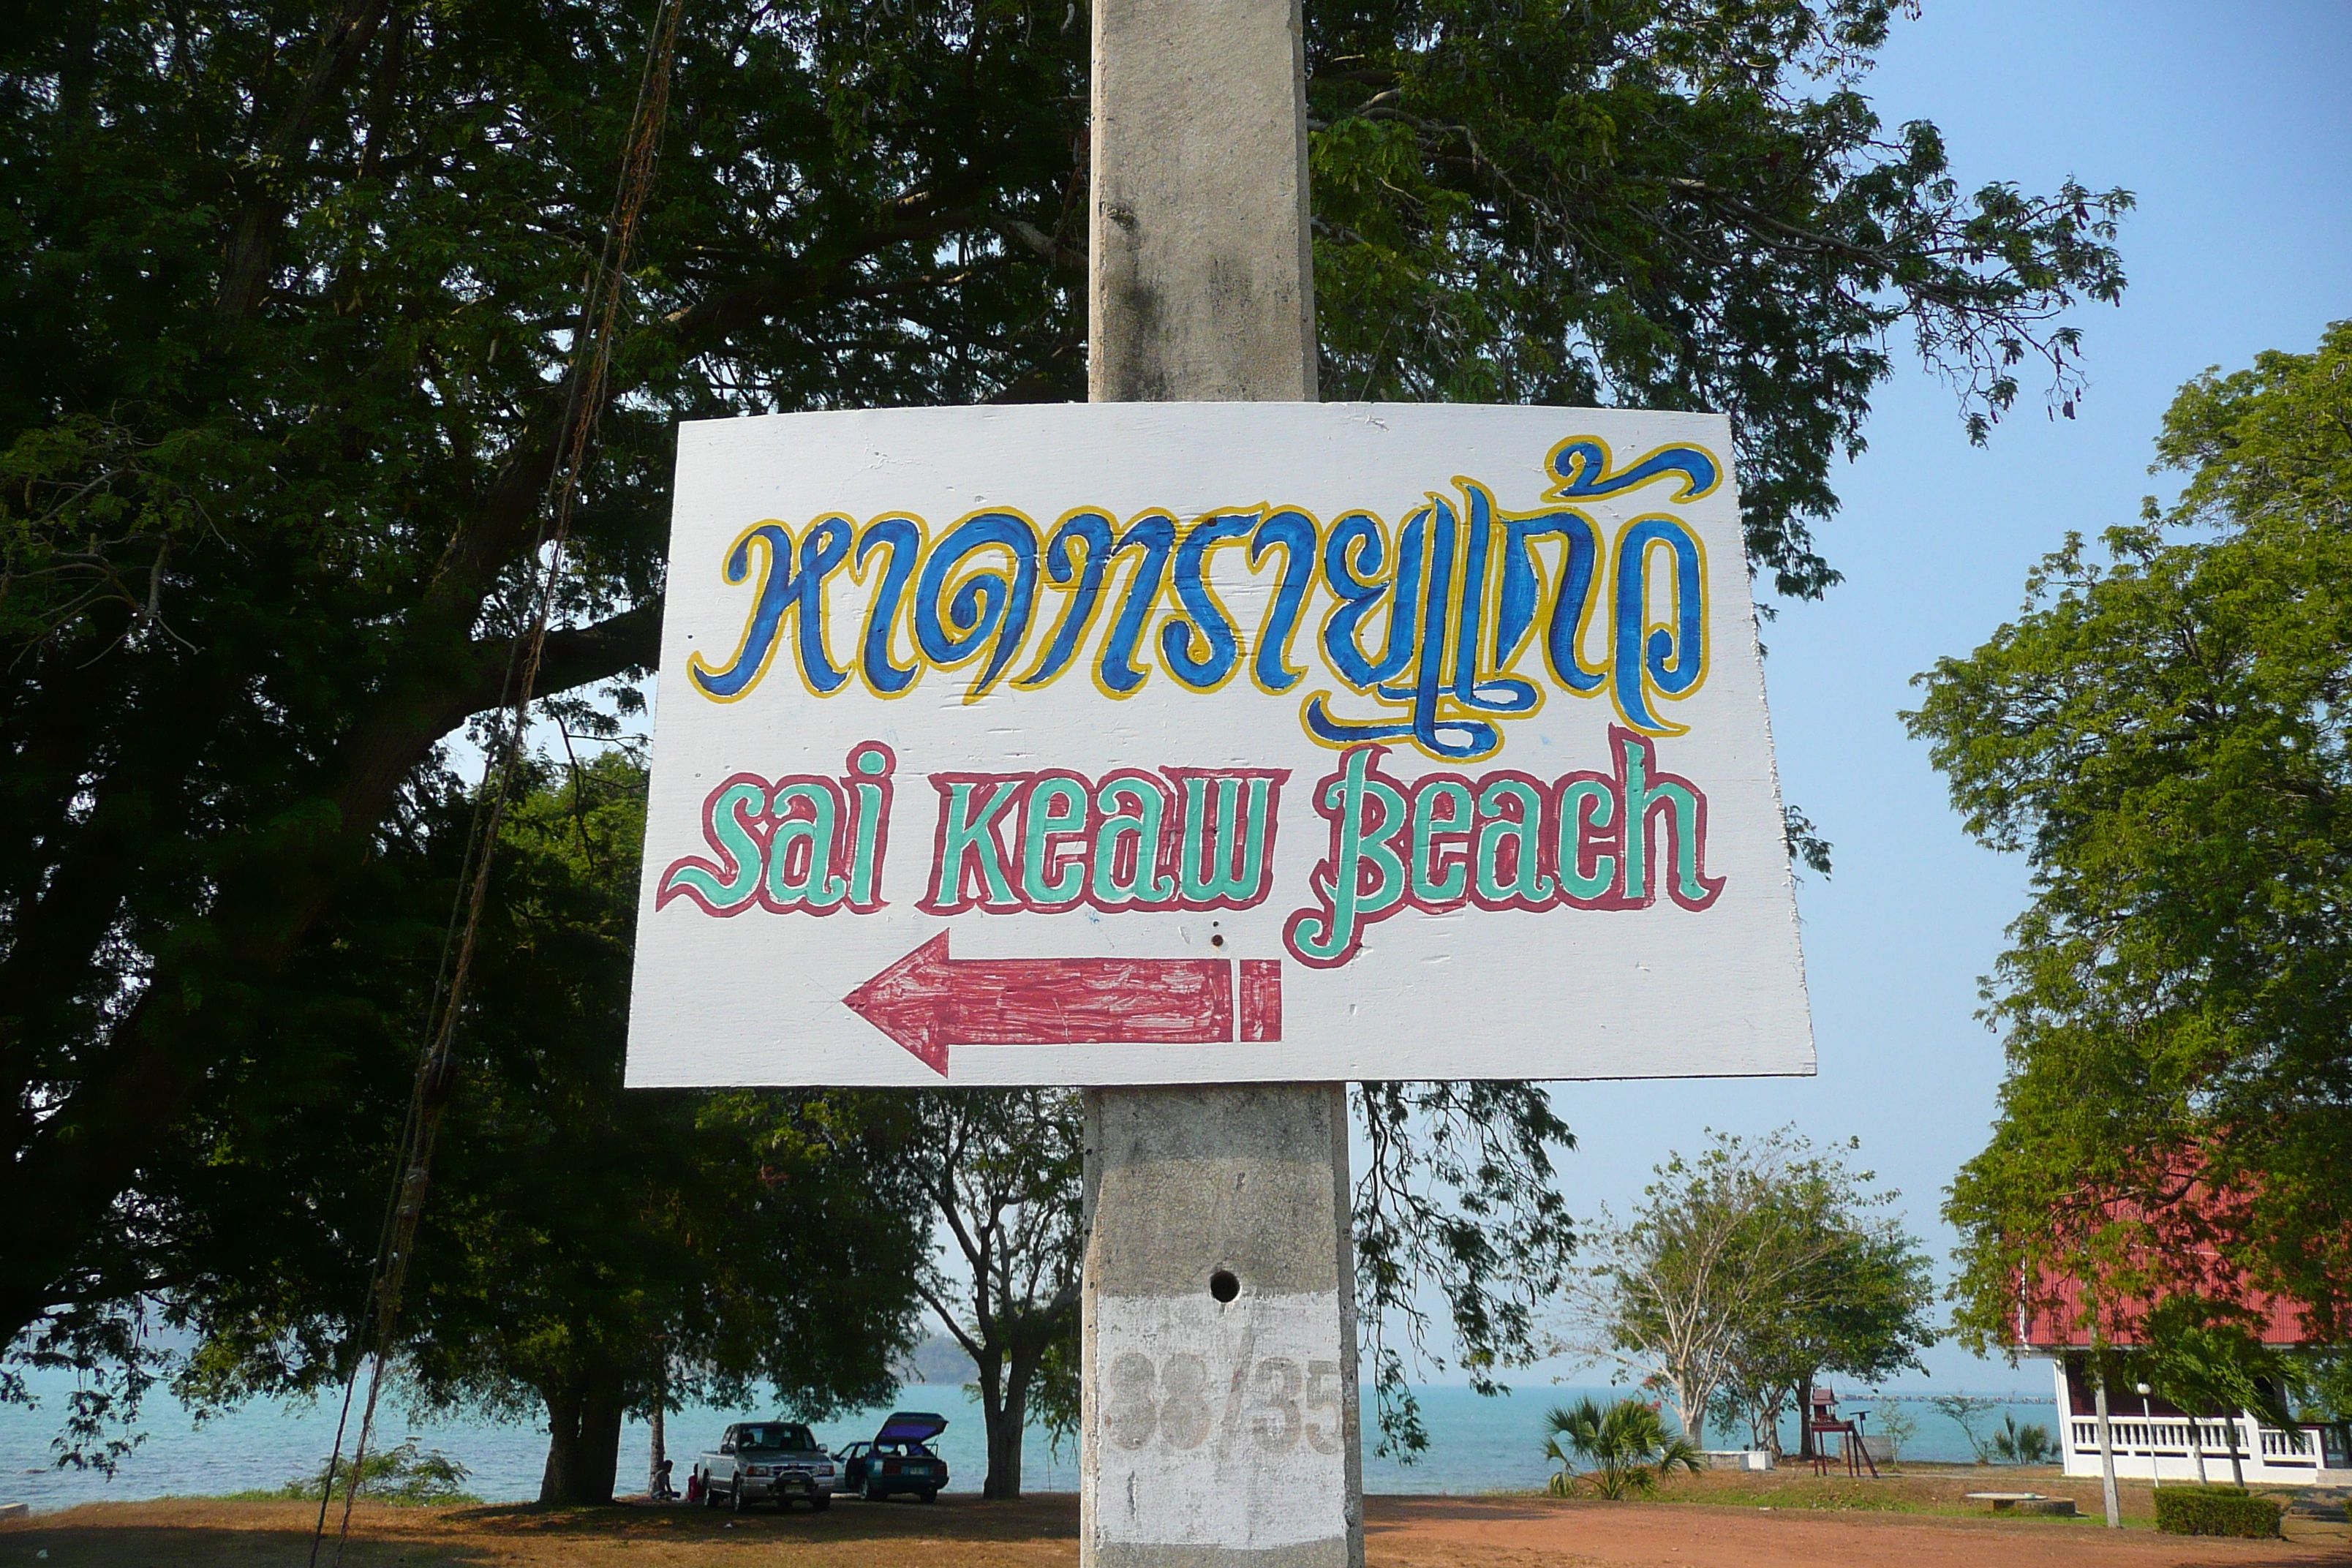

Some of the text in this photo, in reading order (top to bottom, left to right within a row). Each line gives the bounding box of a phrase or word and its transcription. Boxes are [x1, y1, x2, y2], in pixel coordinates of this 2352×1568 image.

[689, 437, 1723, 762] หาดทรายแก้ว
[1283, 724, 1727, 970] Beach
